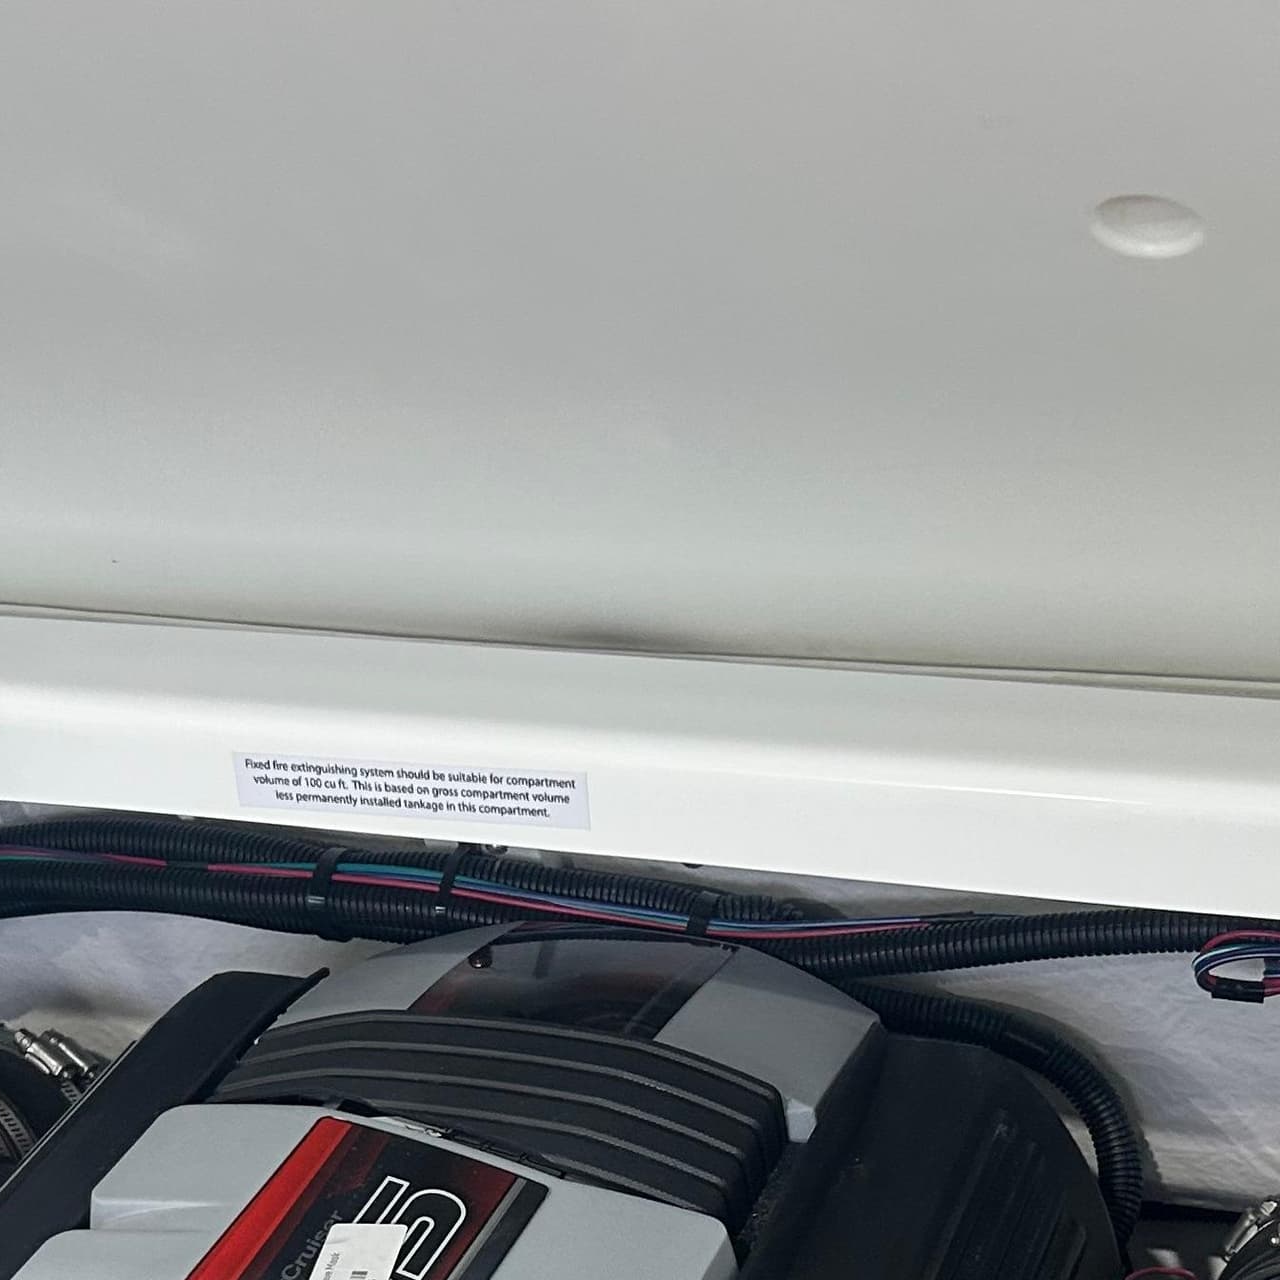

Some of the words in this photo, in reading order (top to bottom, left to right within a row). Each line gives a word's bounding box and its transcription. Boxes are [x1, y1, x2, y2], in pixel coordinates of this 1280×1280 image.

[244, 759, 270, 770] Fixed
[272, 760, 288, 771] fire
[290, 763, 357, 777] extinguishing
[359, 767, 394, 778] system
[396, 768, 430, 780] should
[431, 770, 445, 781] be
[447, 772, 487, 783] suitable
[489, 773, 503, 784] for
[506, 776, 575, 788] compartment
[253, 775, 289, 785] volume
[291, 776, 301, 786] of
[304, 777, 322, 788] 100
[323, 780, 336, 789] cu
[337, 779, 348, 789] ft.
[351, 780, 372, 791] This
[374, 781, 382, 792] is
[383, 782, 414, 794] based
[416, 786, 429, 794] on
[431, 787, 458, 798] gross
[460, 789, 529, 800] compartment
[531, 792, 569, 803] volume
[275, 789, 293, 800] less
[295, 793, 357, 806] permanently
[359, 796, 401, 807] installed
[403, 799, 443, 812] tankage
[445, 801, 455, 811] in
[457, 801, 476, 812] this
[478, 805, 549, 817] compartment.
[325, 1252, 340, 1270] Mask
